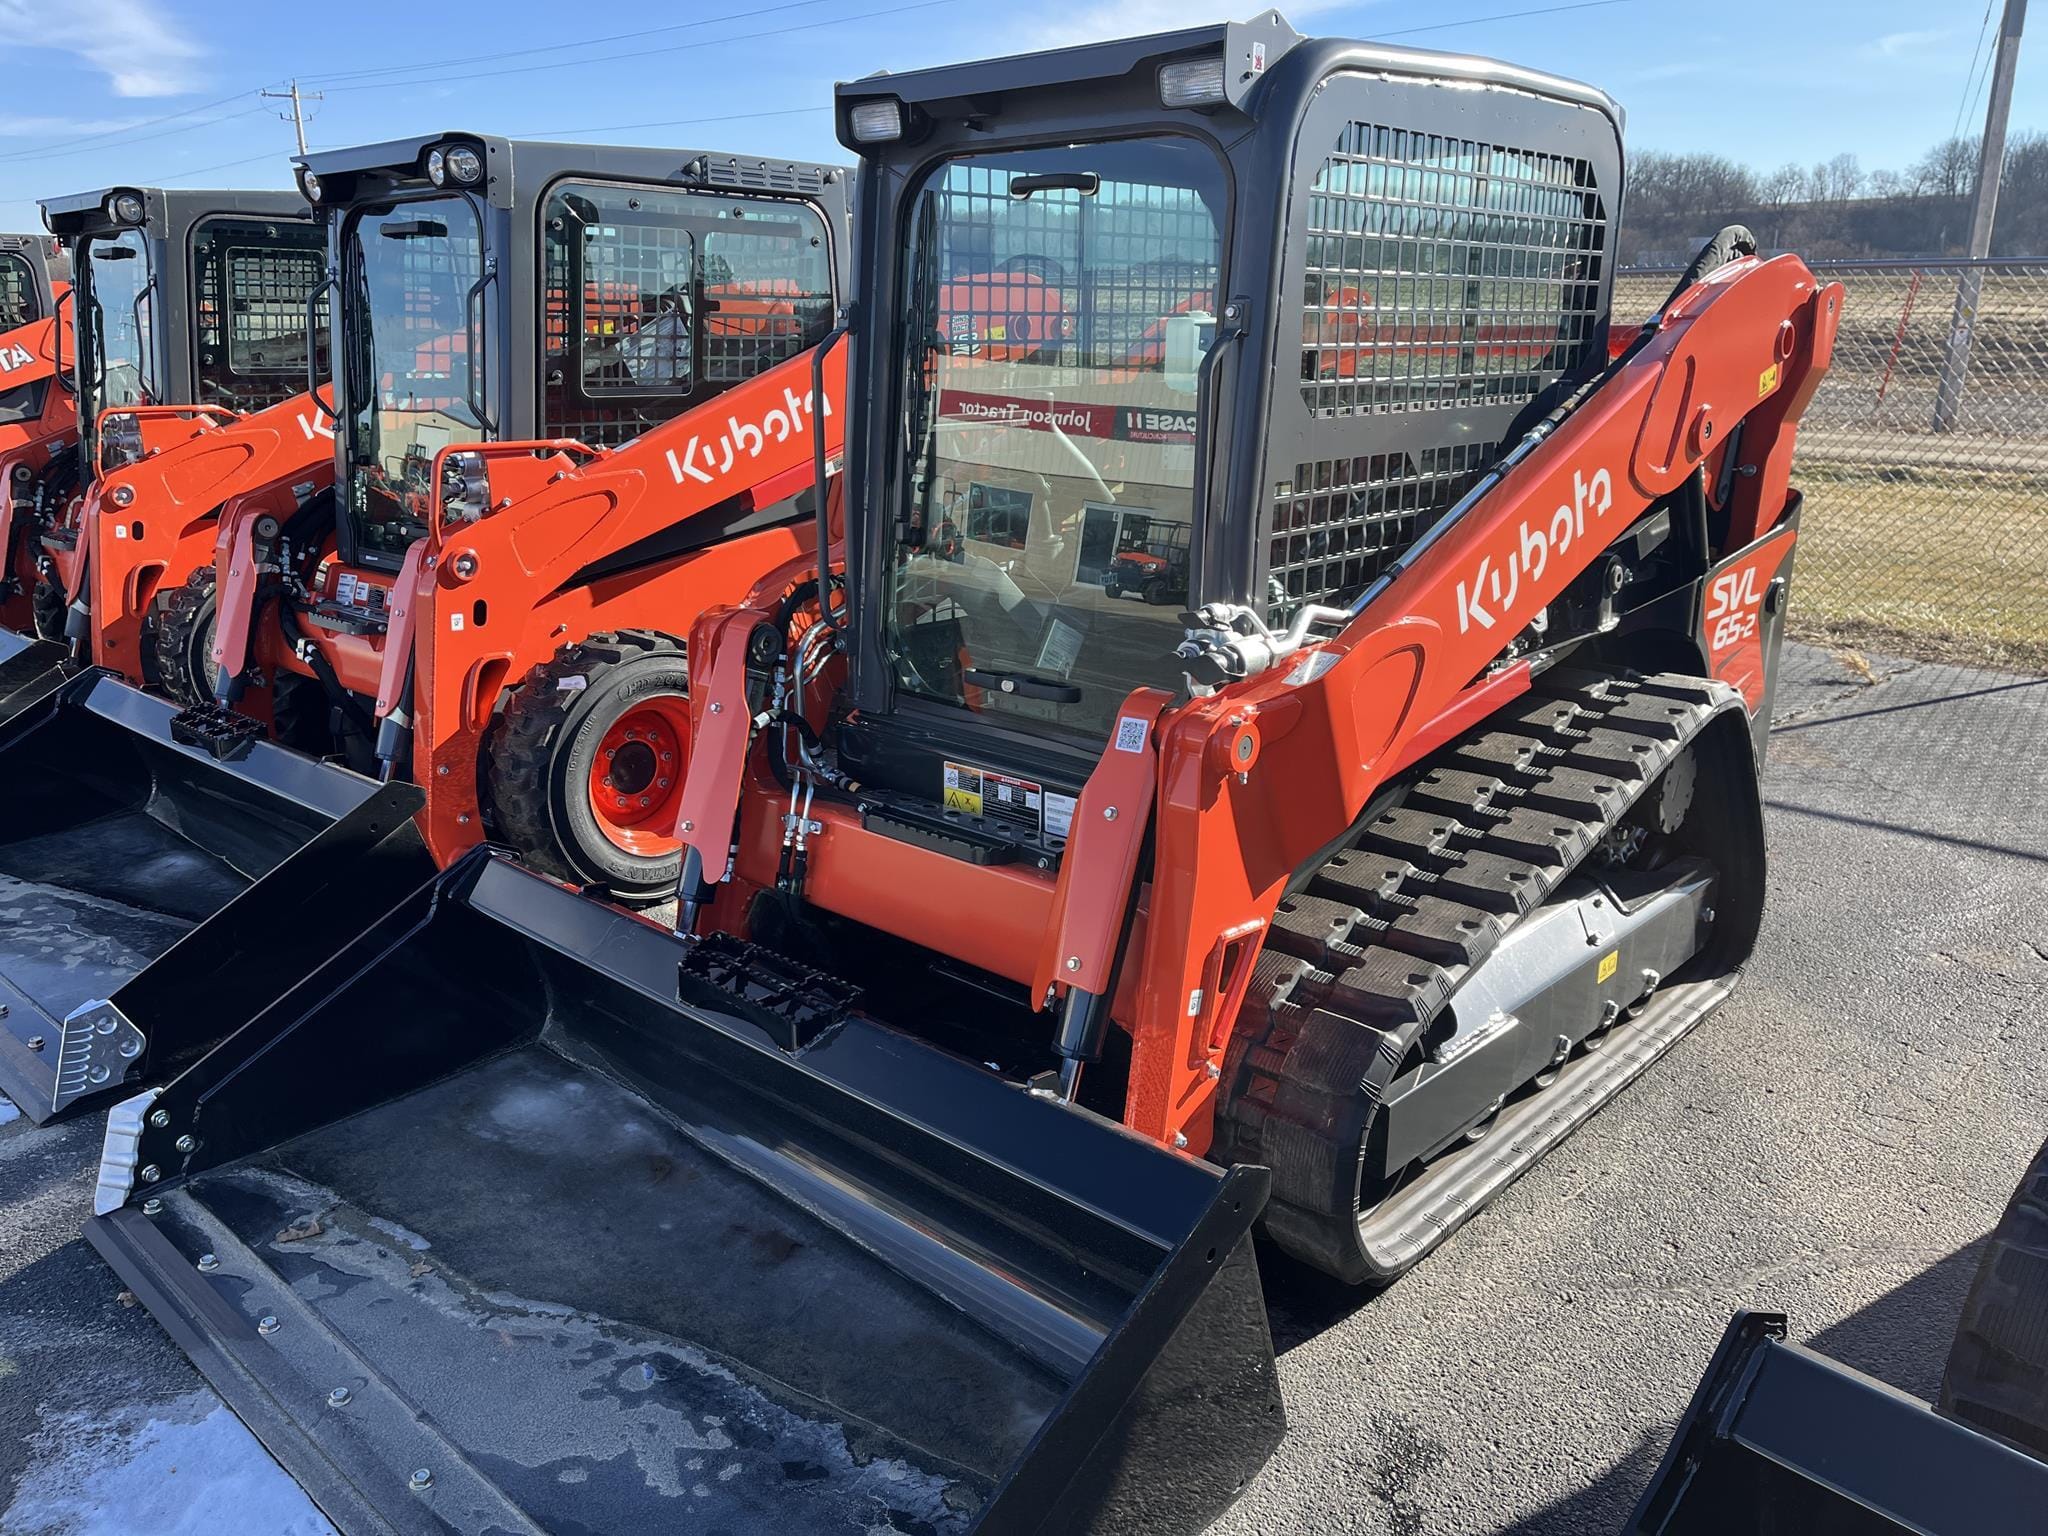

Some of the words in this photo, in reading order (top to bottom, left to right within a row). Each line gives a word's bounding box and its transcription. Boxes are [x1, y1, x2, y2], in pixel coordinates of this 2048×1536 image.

[665, 387, 832, 484] Kubota
[1456, 467, 1612, 635] Kubota
[1707, 566, 1761, 620] SVL
[1712, 610, 1756, 651] 65-2
